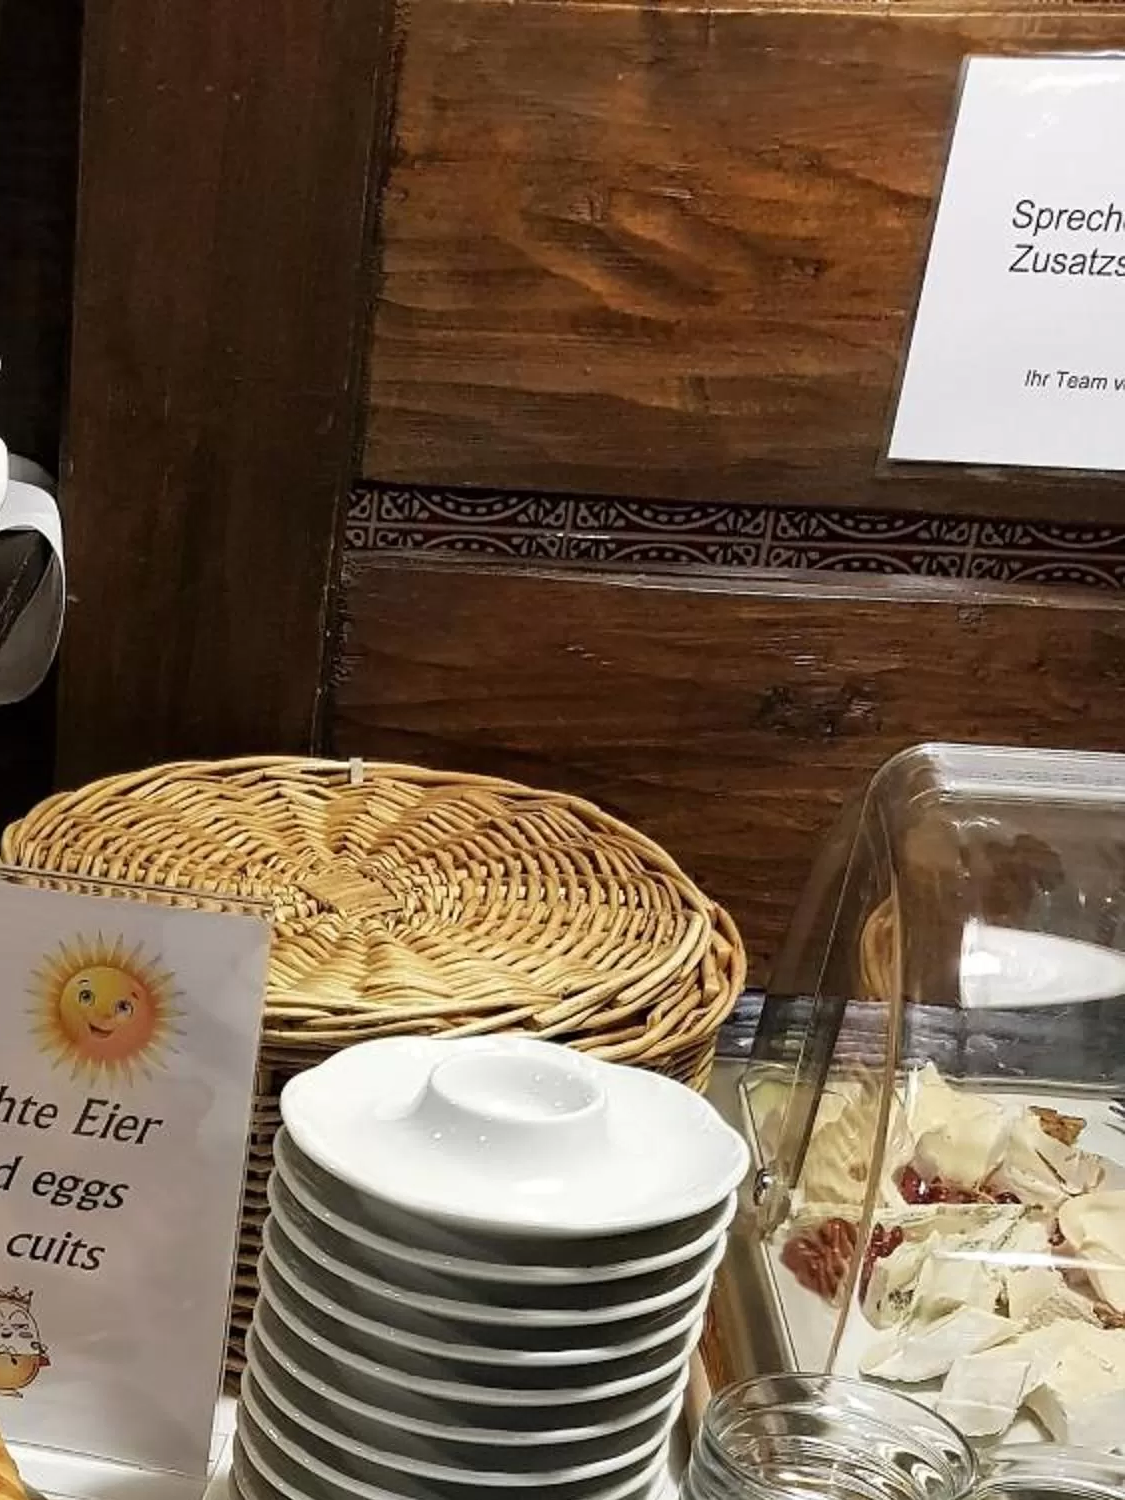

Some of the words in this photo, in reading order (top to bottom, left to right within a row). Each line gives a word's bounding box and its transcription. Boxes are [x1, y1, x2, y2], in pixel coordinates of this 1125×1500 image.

[1011, 199, 1125, 237] Sprech
[1024, 369, 1051, 388] Ihr
[1056, 370, 1109, 391] Team
[71, 1097, 164, 1145] Eier
[31, 1169, 130, 1211] eggs
[6, 1231, 106, 1272] cuits
